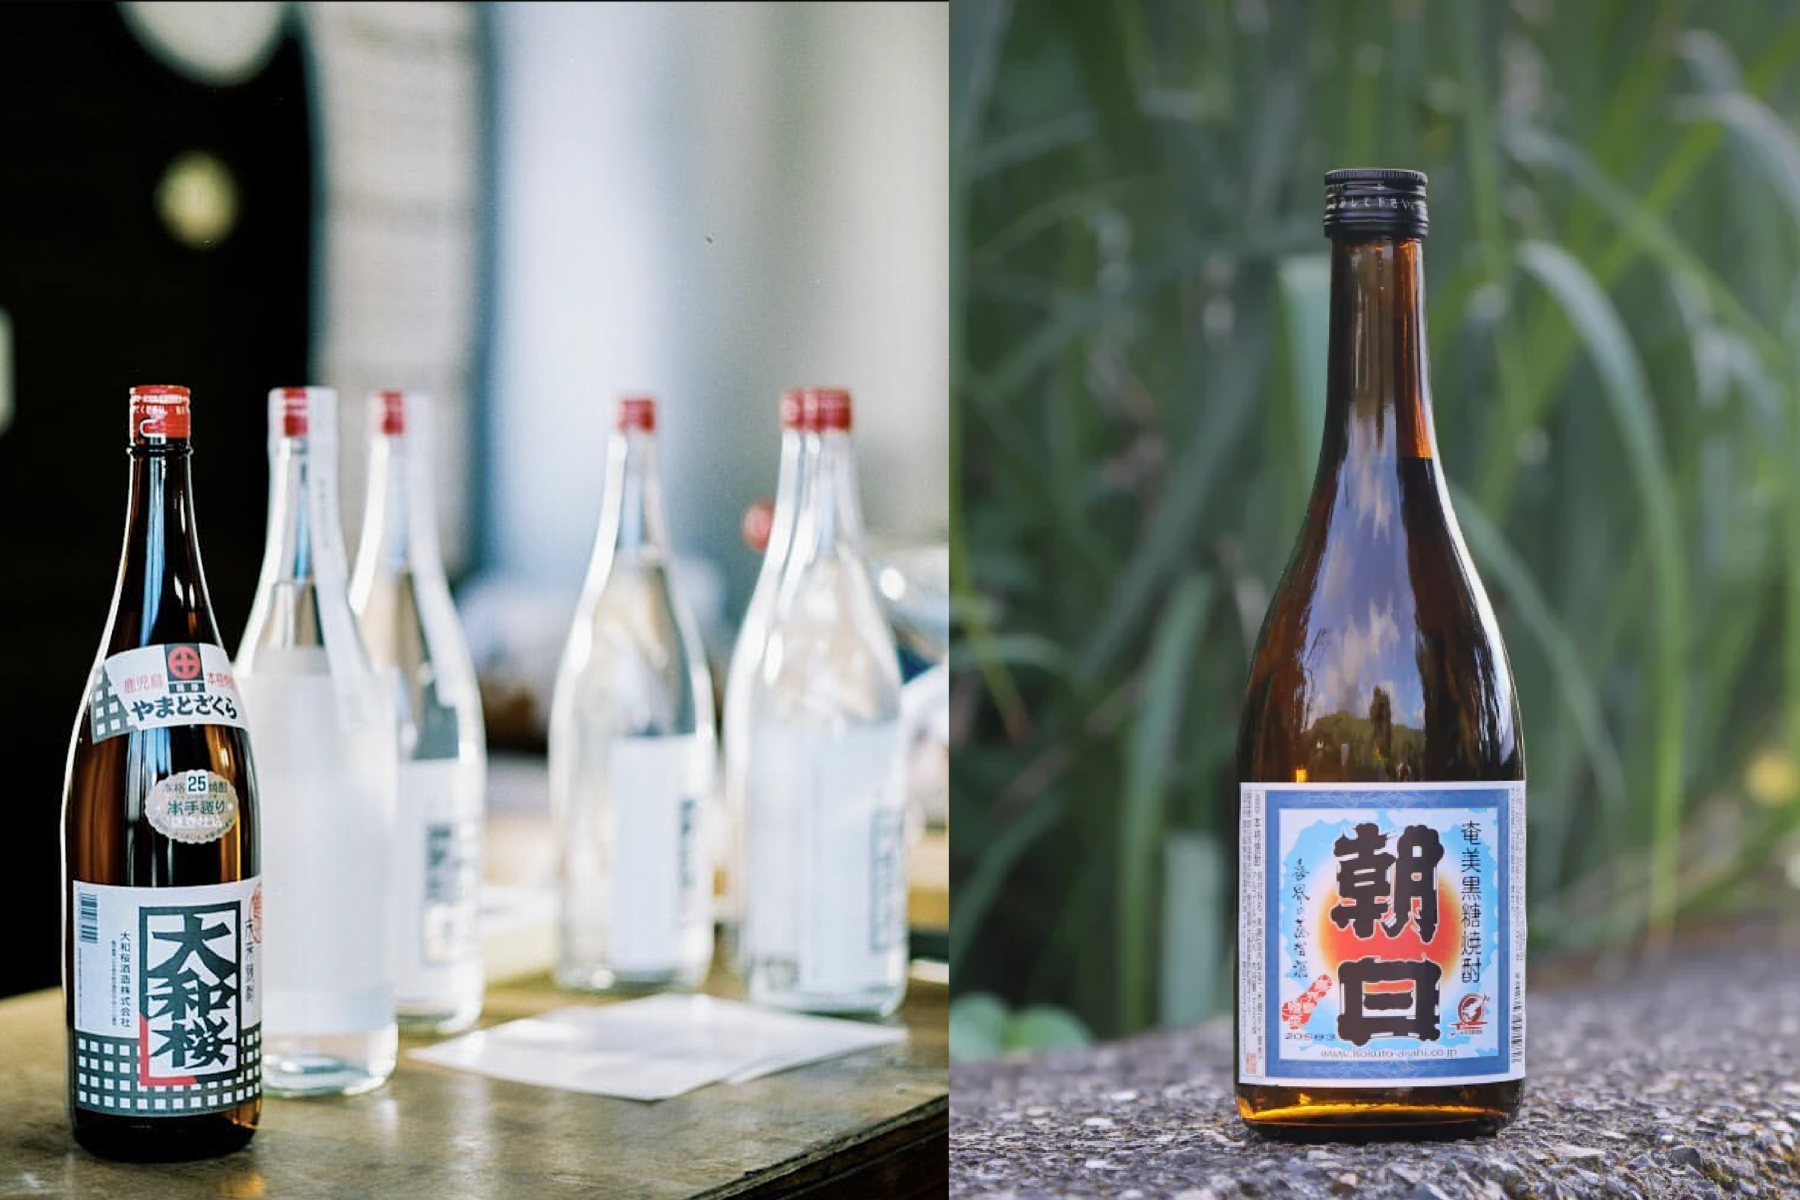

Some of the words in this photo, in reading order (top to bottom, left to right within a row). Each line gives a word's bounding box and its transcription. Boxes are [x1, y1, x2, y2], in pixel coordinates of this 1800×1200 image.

[131, 695, 238, 721] やまとざくら
[187, 775, 206, 792] 25
[1330, 823, 1445, 1047] 朝日
[1460, 820, 1482, 984] 奄美黒糖焼酎
[146, 912, 238, 1070] 大和桜
